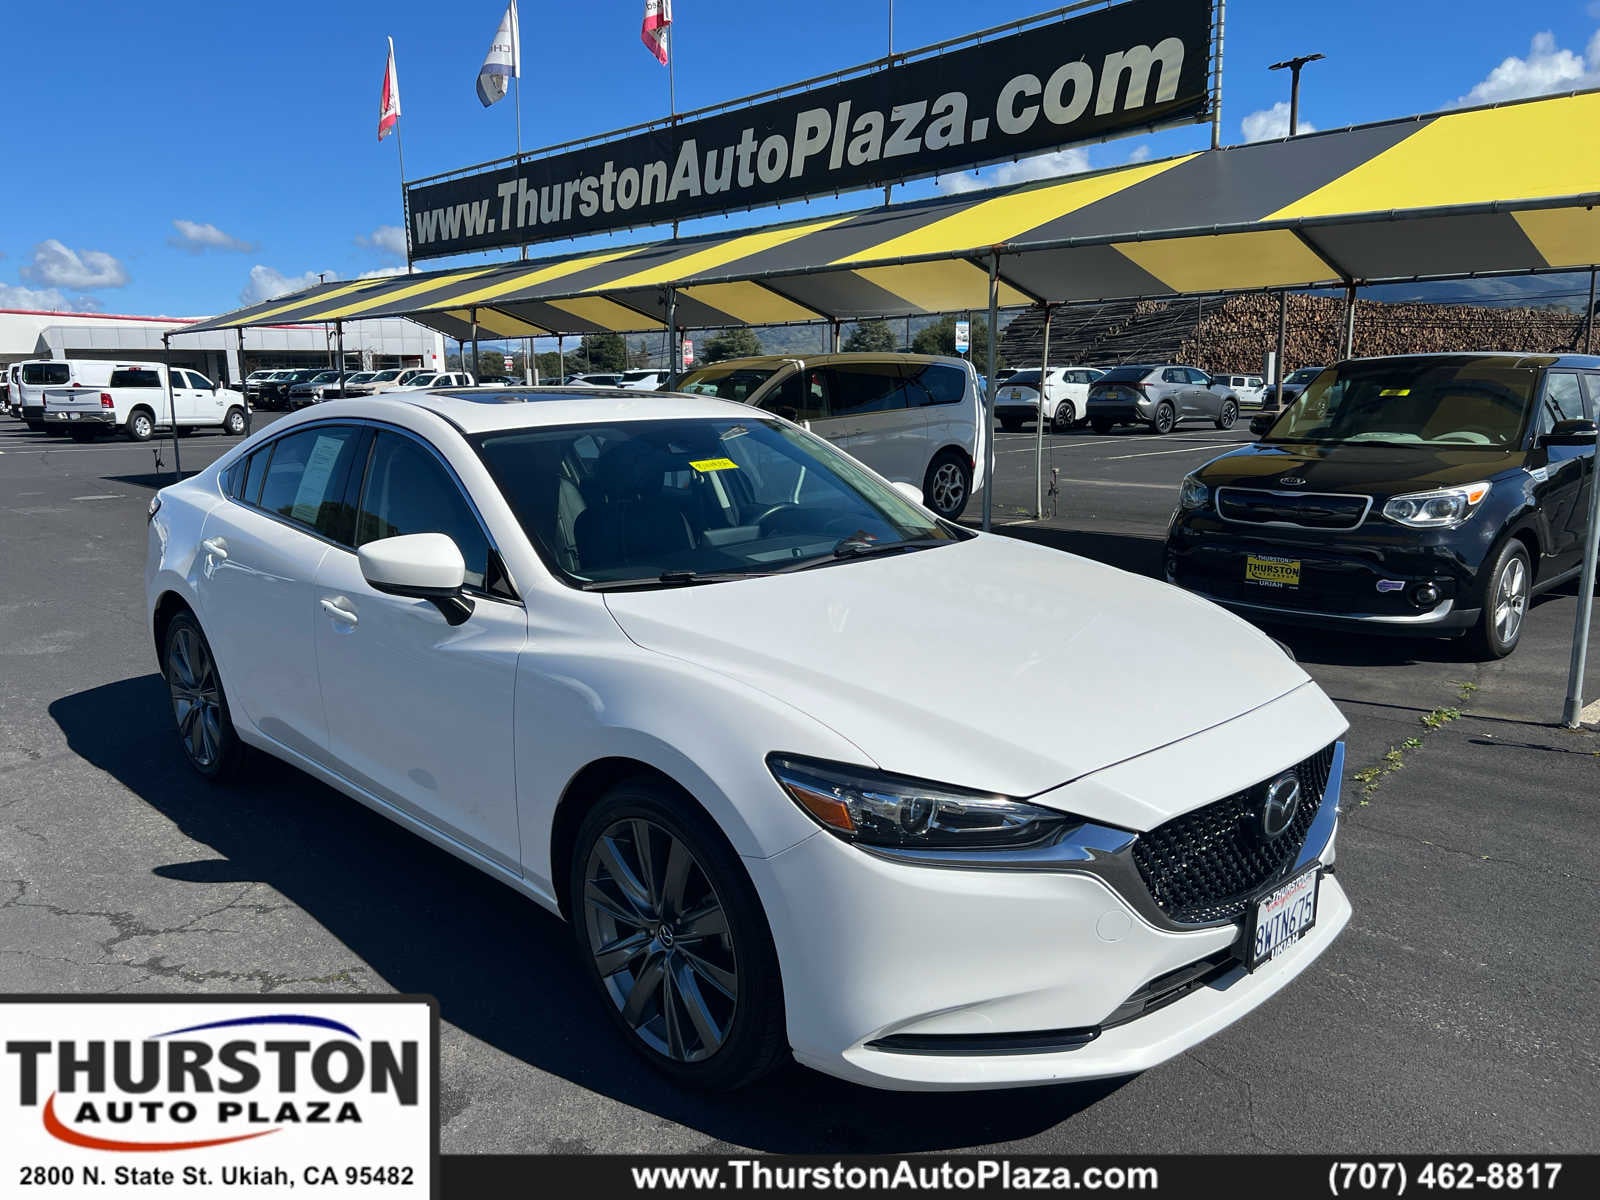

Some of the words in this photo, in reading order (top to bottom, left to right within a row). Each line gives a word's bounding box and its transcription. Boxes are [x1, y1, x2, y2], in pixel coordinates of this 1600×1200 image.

[415, 37, 1185, 244] www.ThurstonAutoPlaza.com
[1247, 563, 1299, 577] THURSTON
[1255, 891, 1313, 957] 8WTN675
